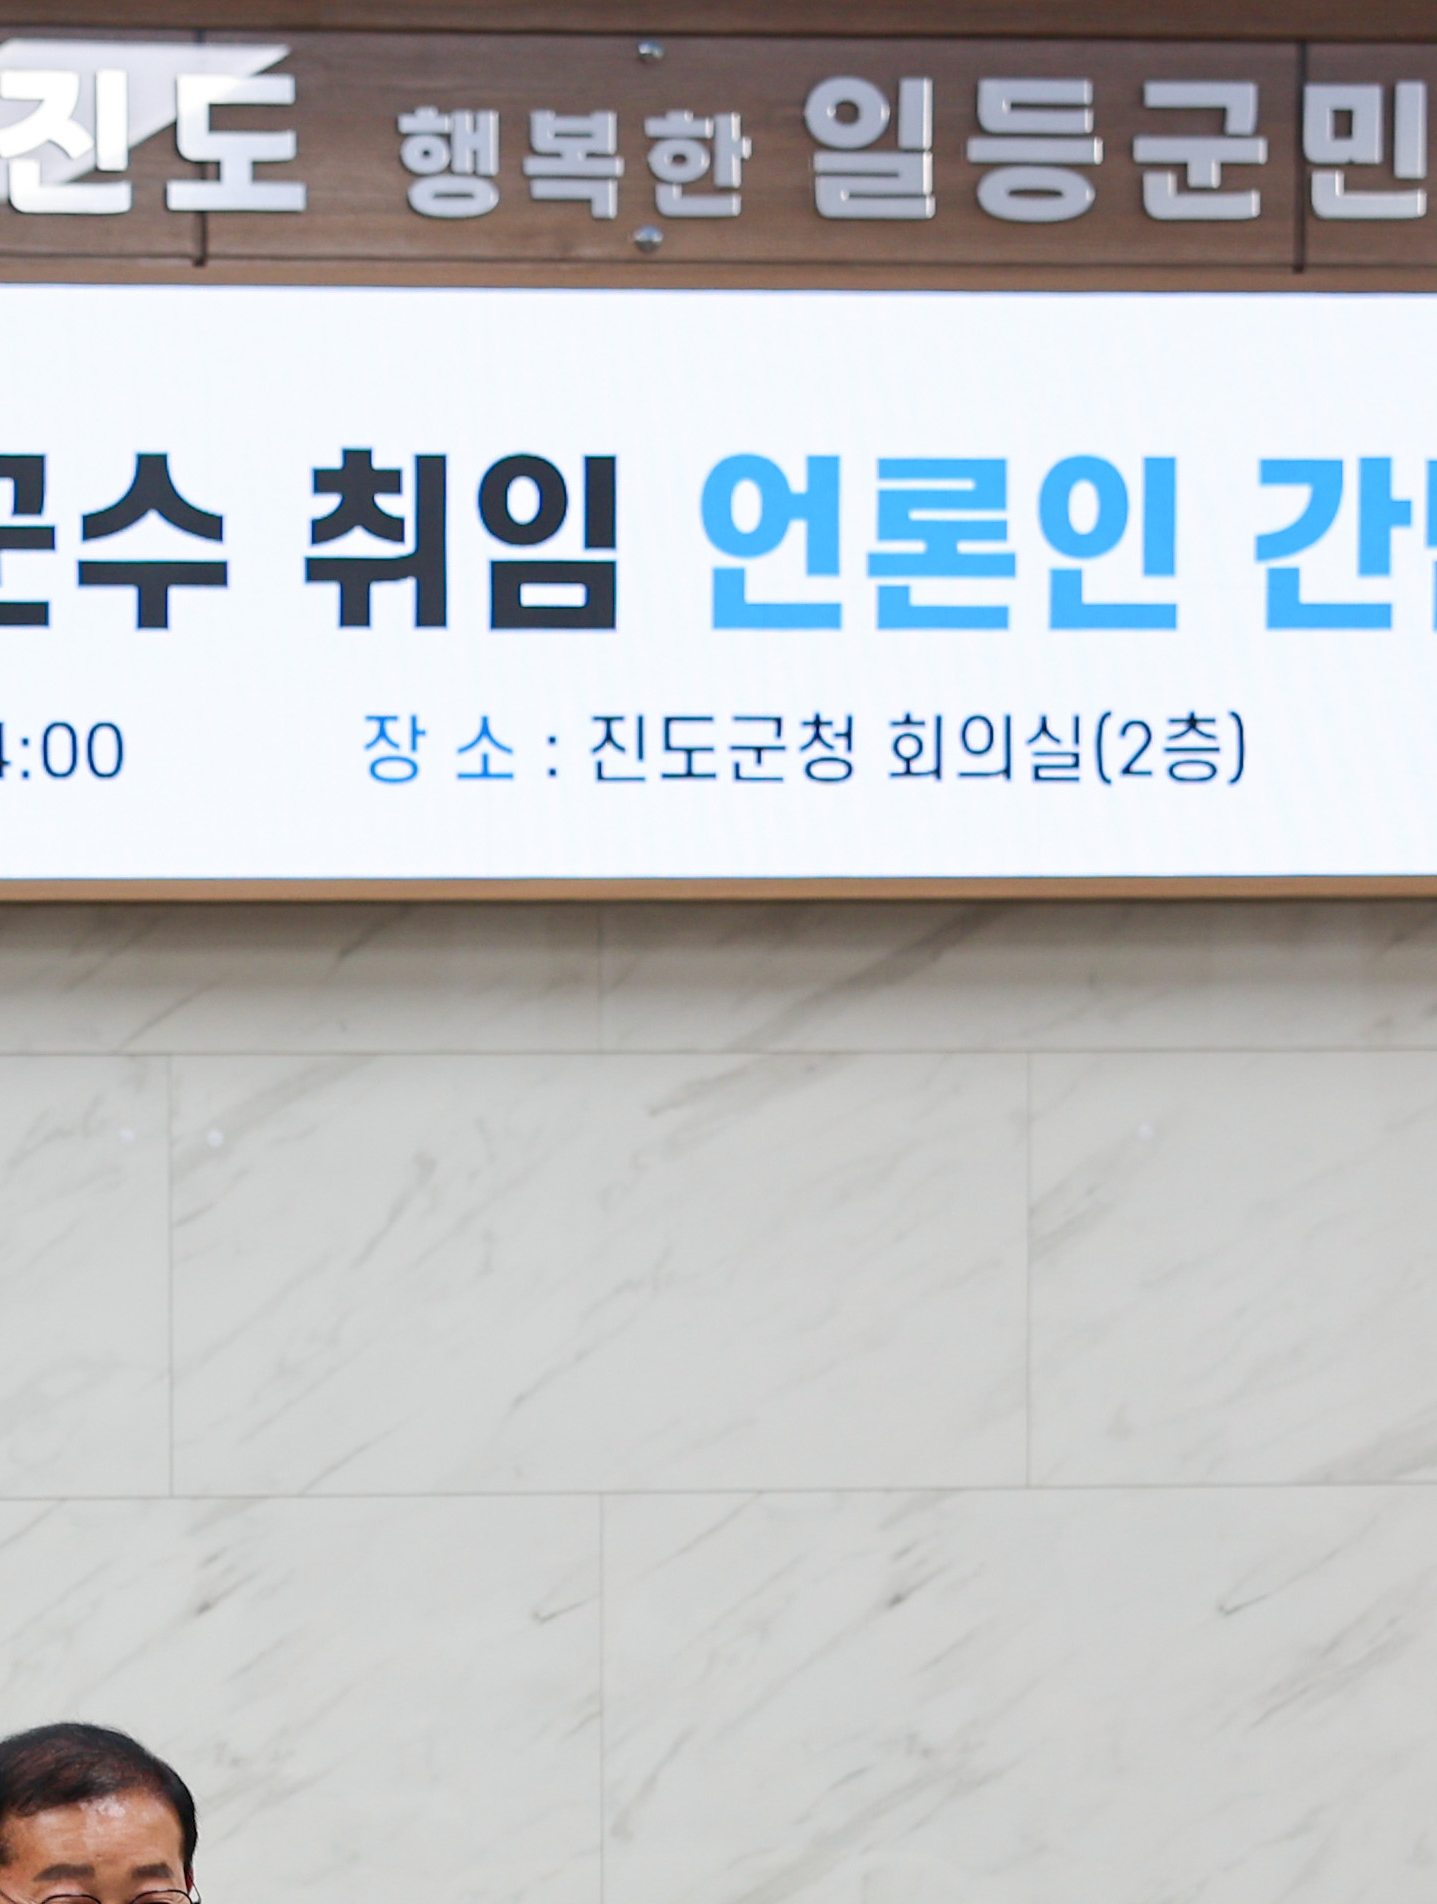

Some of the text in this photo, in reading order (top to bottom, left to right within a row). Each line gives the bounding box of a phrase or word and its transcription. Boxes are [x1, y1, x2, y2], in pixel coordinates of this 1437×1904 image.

[397, 105, 752, 220] 행복한
[804, 76, 1428, 224] 일등군민
[304, 447, 618, 632] 취임
[700, 453, 1179, 632] 언론인
[589, 711, 854, 784] 진도군청
[888, 709, 1246, 787] 회의실(2층)
